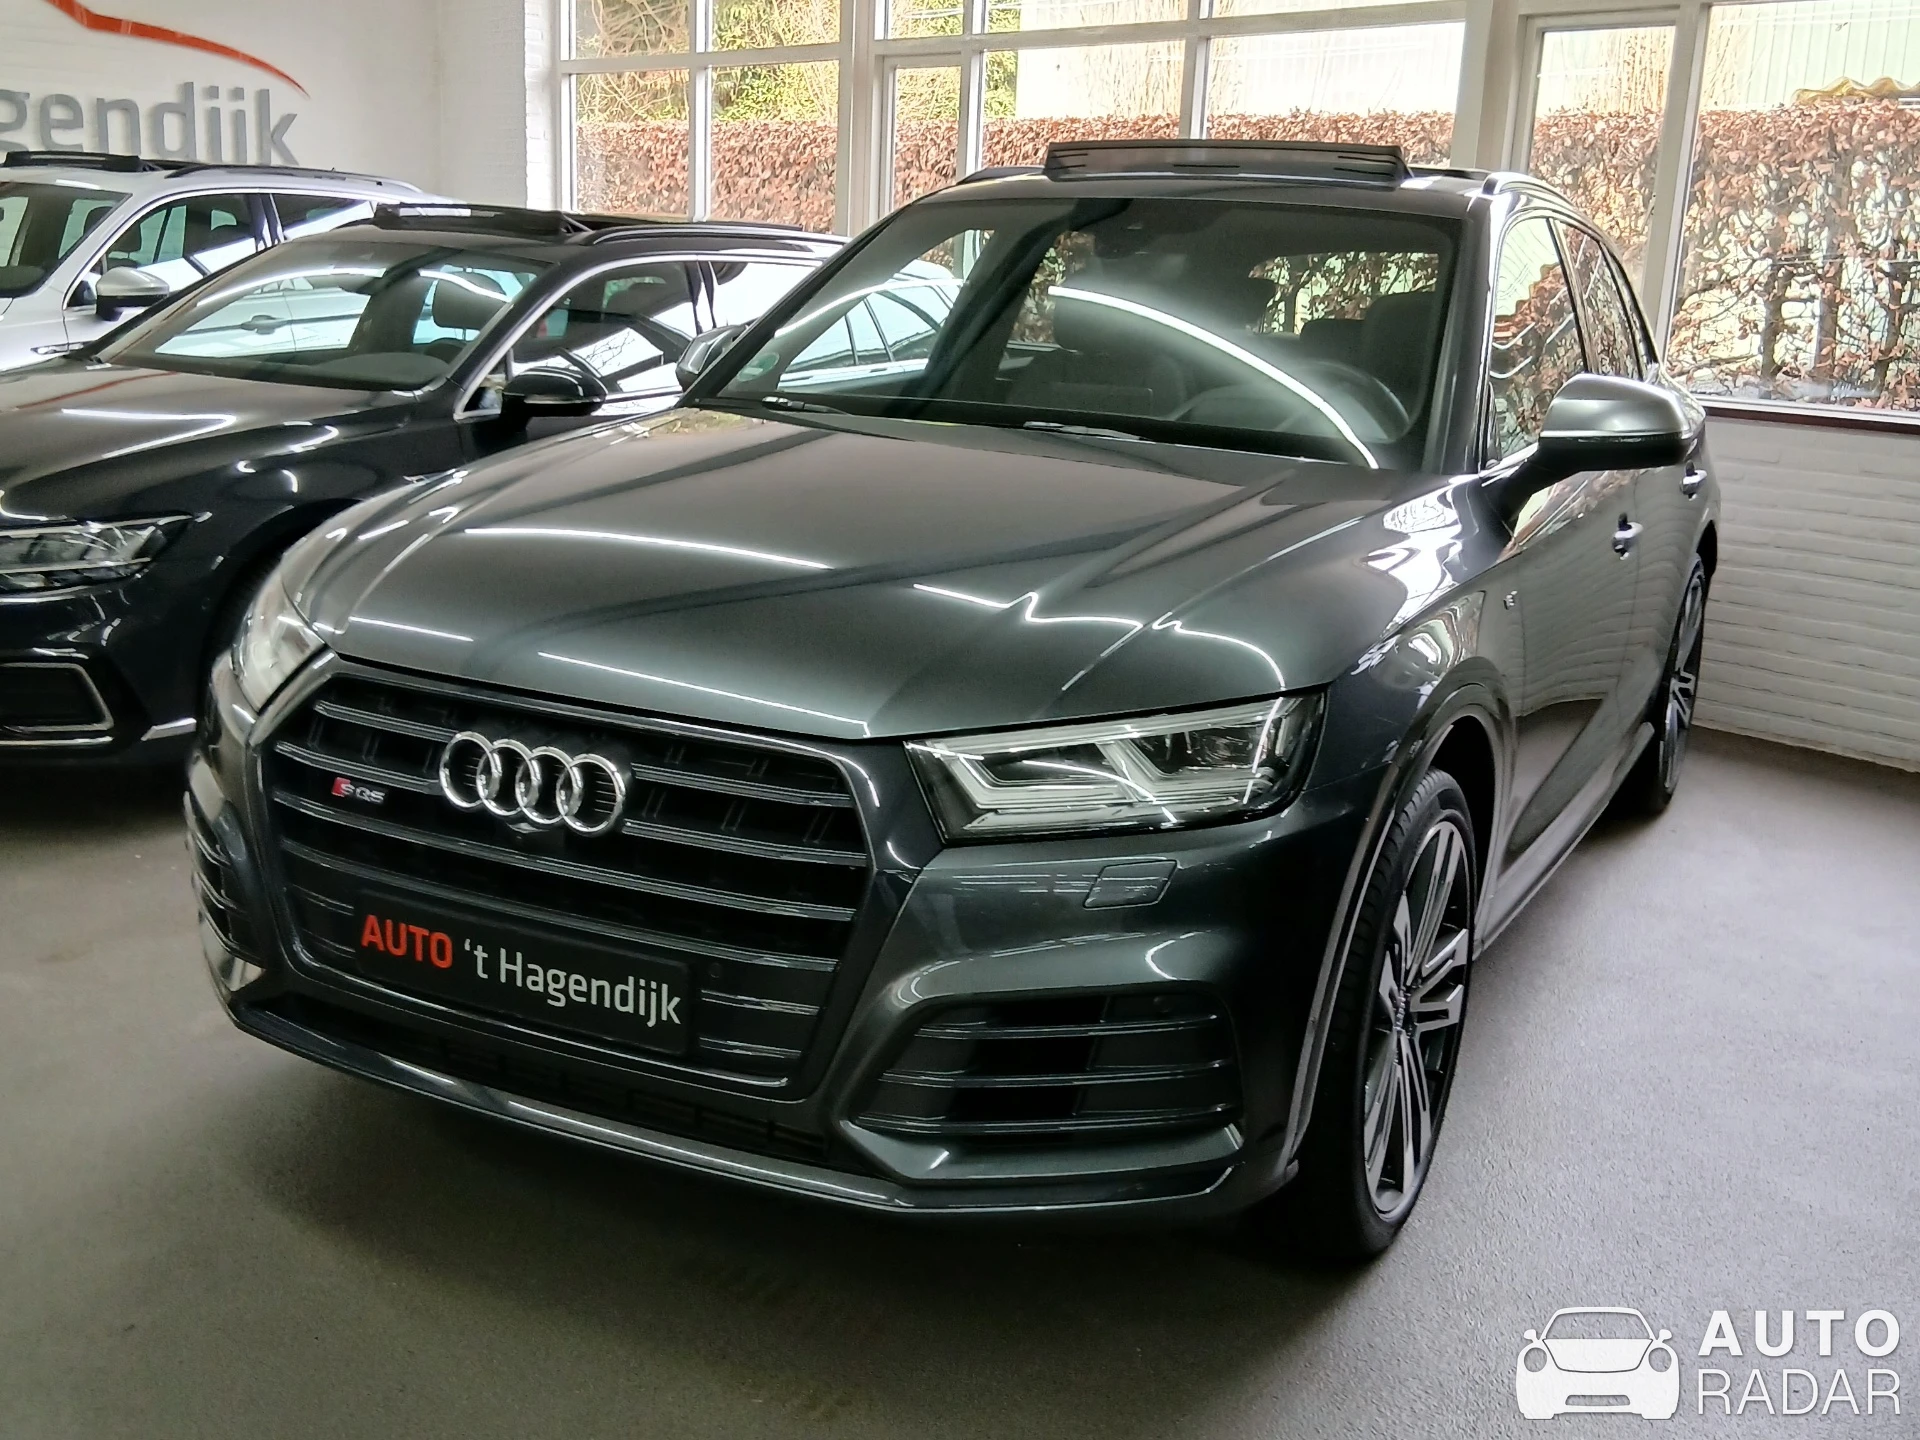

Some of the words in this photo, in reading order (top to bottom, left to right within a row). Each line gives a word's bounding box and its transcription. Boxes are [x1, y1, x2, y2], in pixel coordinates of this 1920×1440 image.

[336, 779, 386, 804] SQ5
[361, 914, 453, 969] AUTO
[499, 947, 682, 1028] Hagendijk
